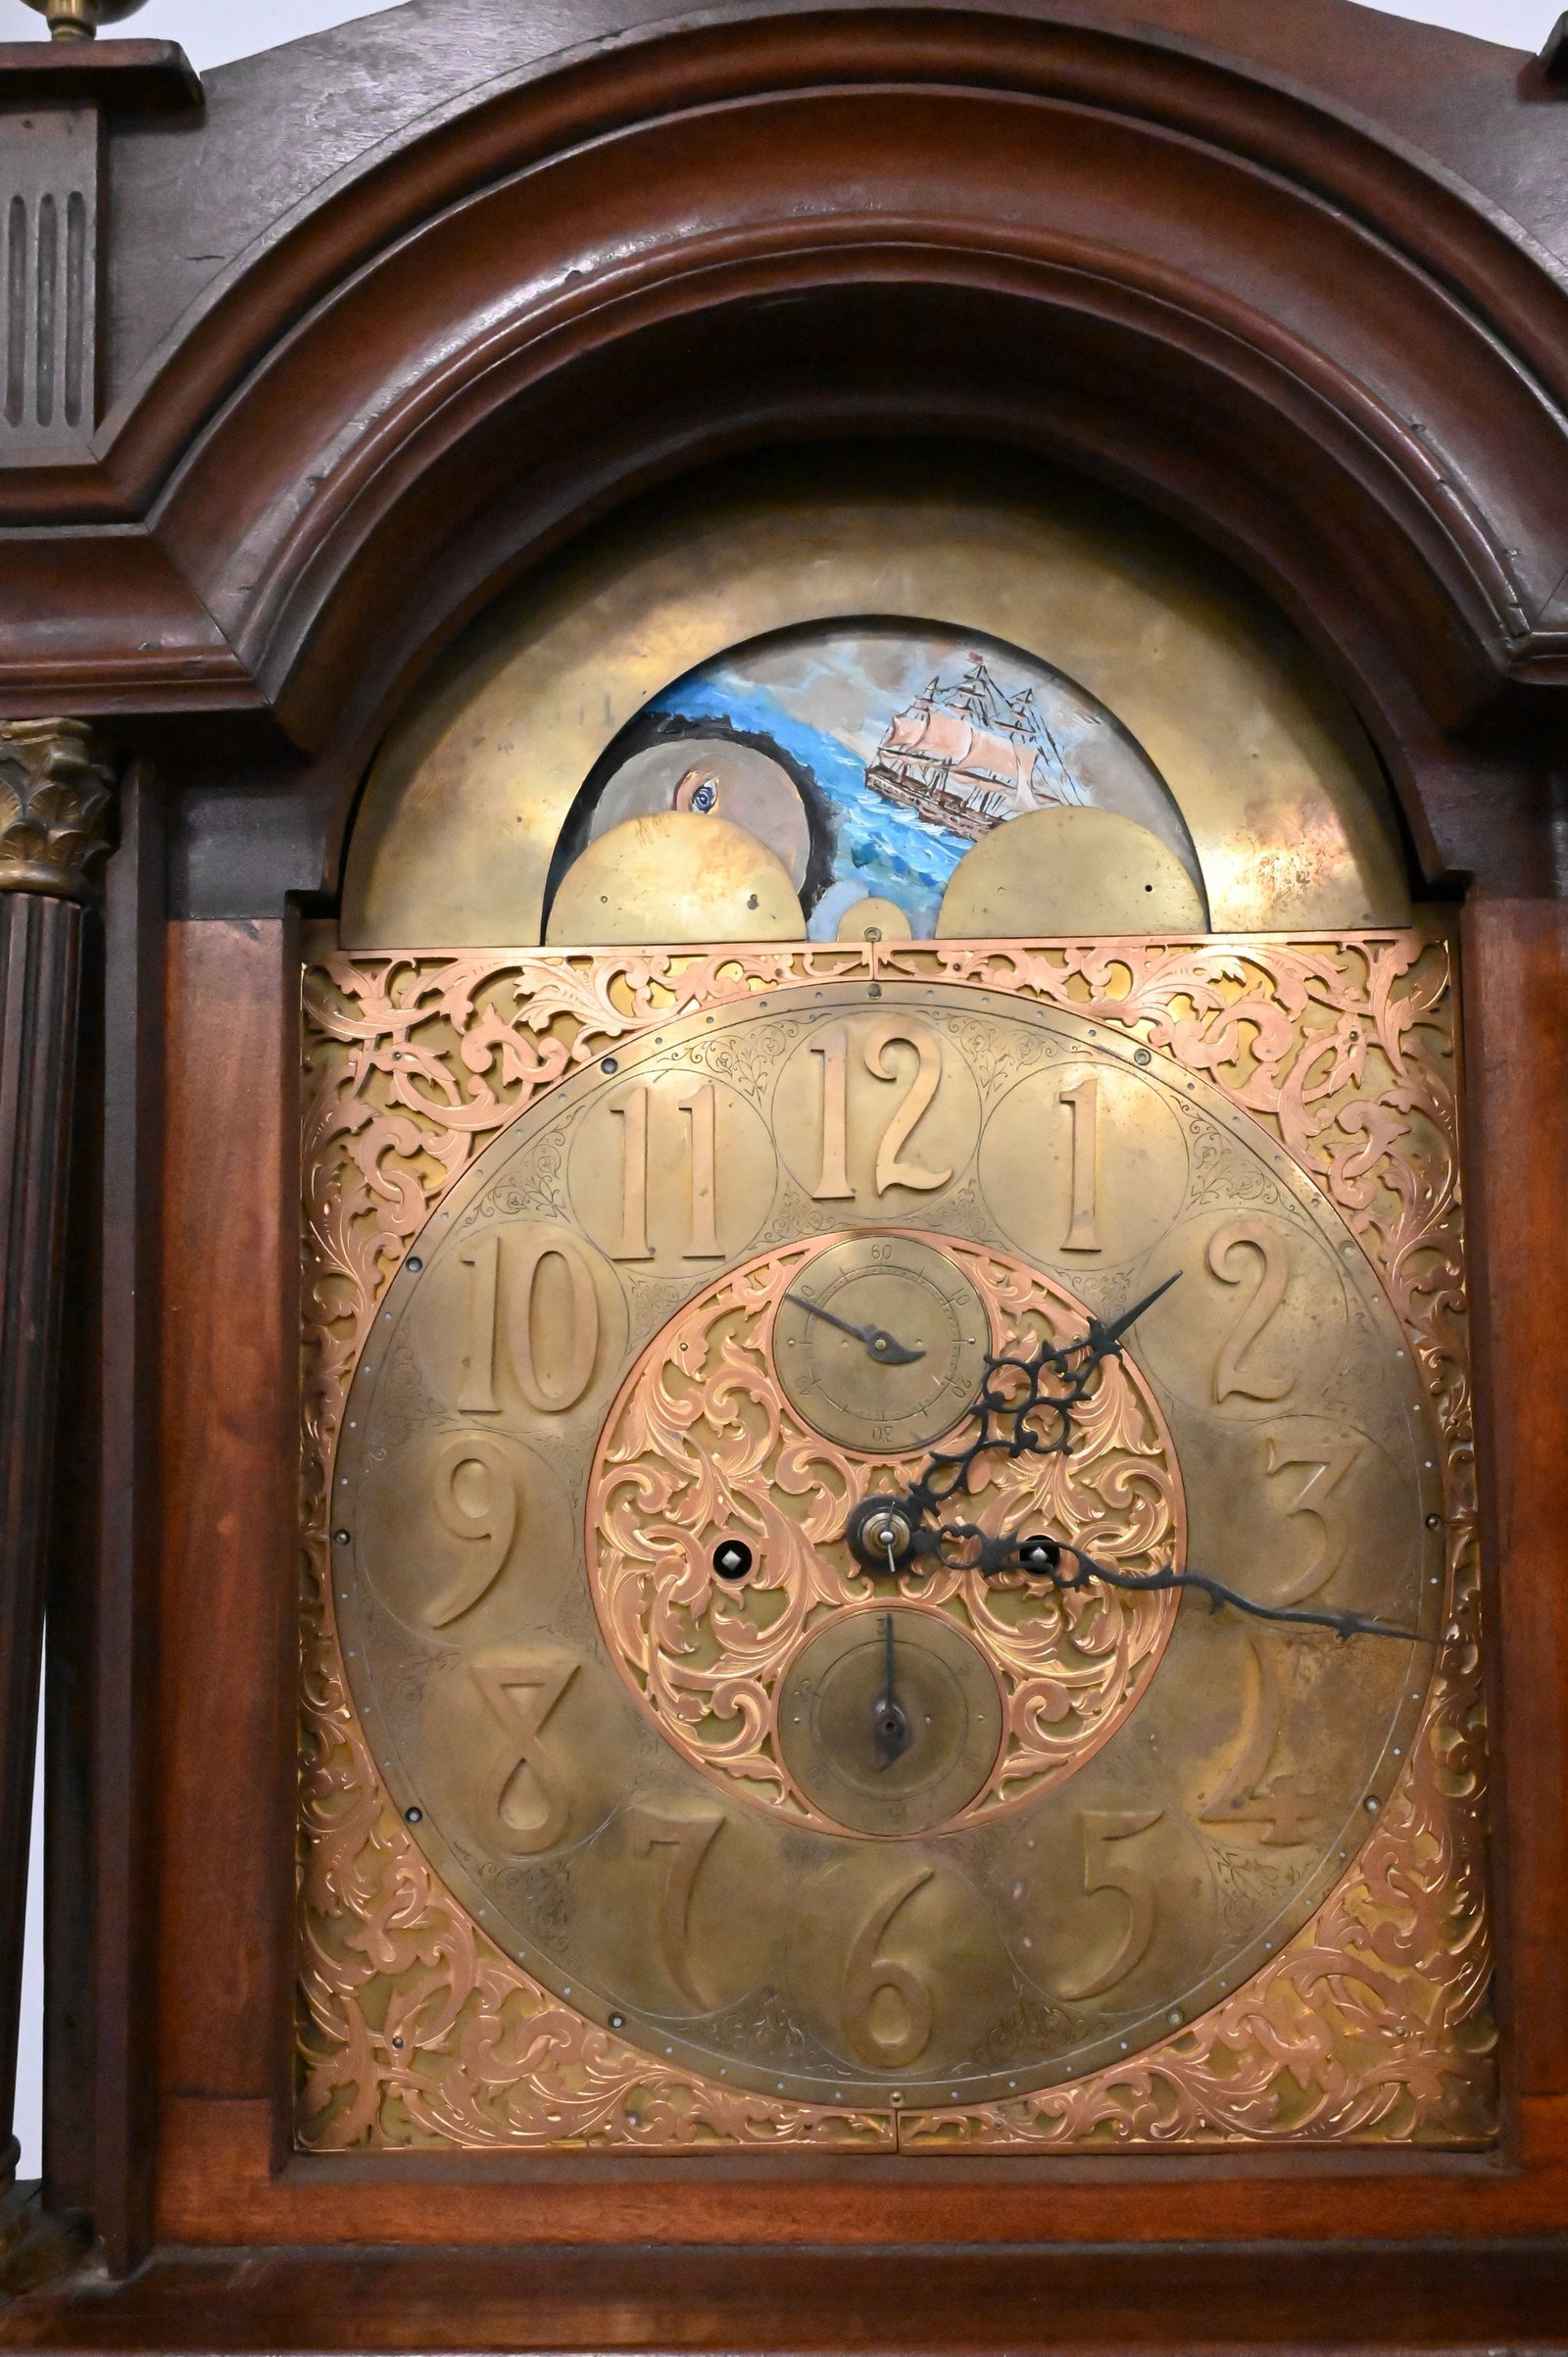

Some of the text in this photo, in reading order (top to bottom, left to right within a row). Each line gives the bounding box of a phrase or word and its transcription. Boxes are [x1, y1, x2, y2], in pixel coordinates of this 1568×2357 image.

[610, 1085, 725, 1261] 11
[810, 1025, 954, 1200] 12
[1059, 1077, 1102, 1252] 1
[458, 1236, 600, 1415] 10
[870, 1244, 893, 1260] 60
[952, 1287, 971, 1307] 10
[1205, 1219, 1297, 1403] 2
[871, 1426, 894, 1444] 30
[951, 1379, 972, 1399] 20
[425, 1437, 518, 1630] 9
[1265, 1436, 1363, 1612] 3
[470, 1649, 583, 1855] 8
[1198, 1635, 1320, 1846] 4
[630, 1805, 726, 2014] 7
[840, 1866, 935, 2069] 6
[1057, 1809, 1166, 2001] 5
